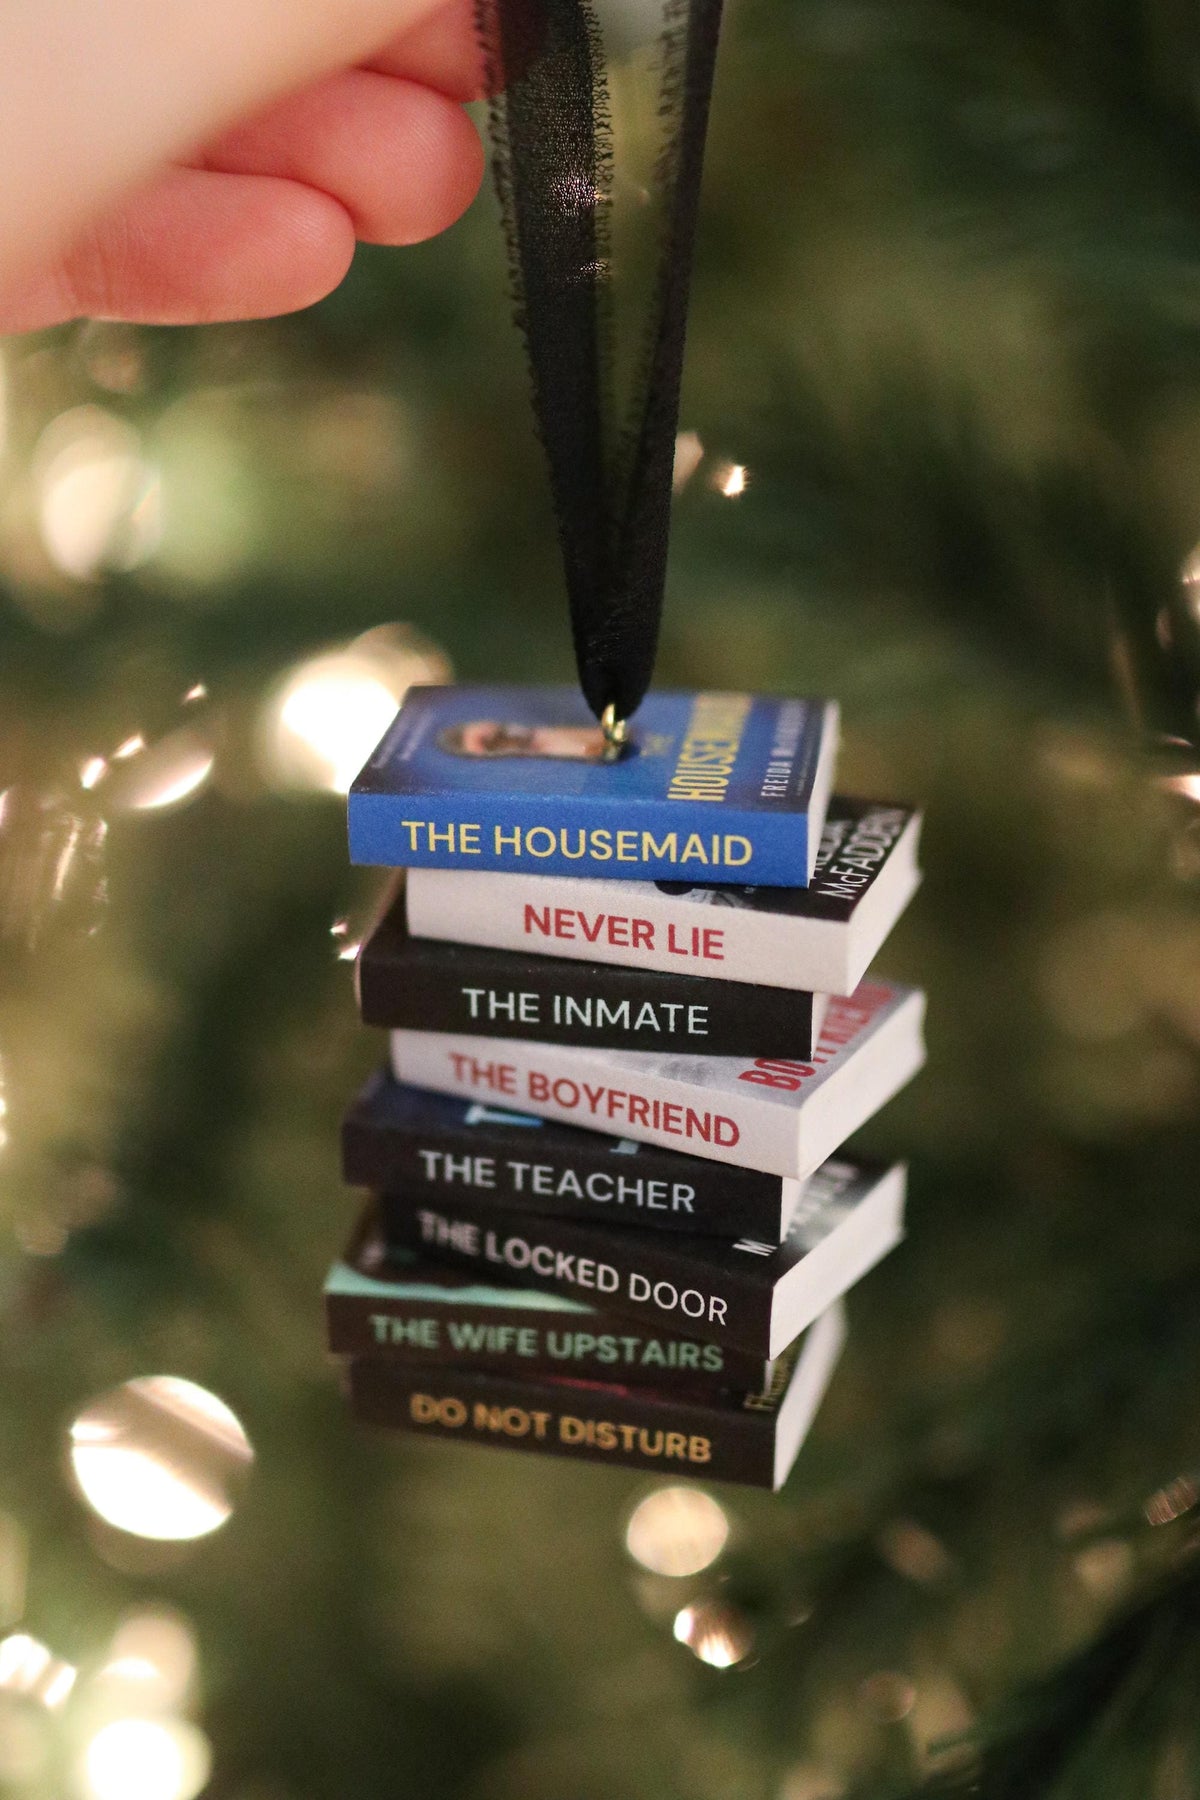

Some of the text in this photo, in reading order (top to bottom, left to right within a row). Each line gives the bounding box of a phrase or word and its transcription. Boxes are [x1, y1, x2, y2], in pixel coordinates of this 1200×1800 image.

[667, 692, 754, 801] HOUSE
[401, 821, 753, 866] THE HOUSEMAID
[524, 904, 726, 960] NEVER LIE
[462, 987, 709, 1035] THE INMATE
[448, 1052, 741, 1148] THE BOYFRIEND
[418, 1149, 696, 1213] THE TEACHER
[417, 1210, 729, 1327] THE LOCKED DOOR
[370, 1313, 725, 1373] THE WIFE UPSTAIRS
[409, 1393, 713, 1464] DO NOT DISTURB
